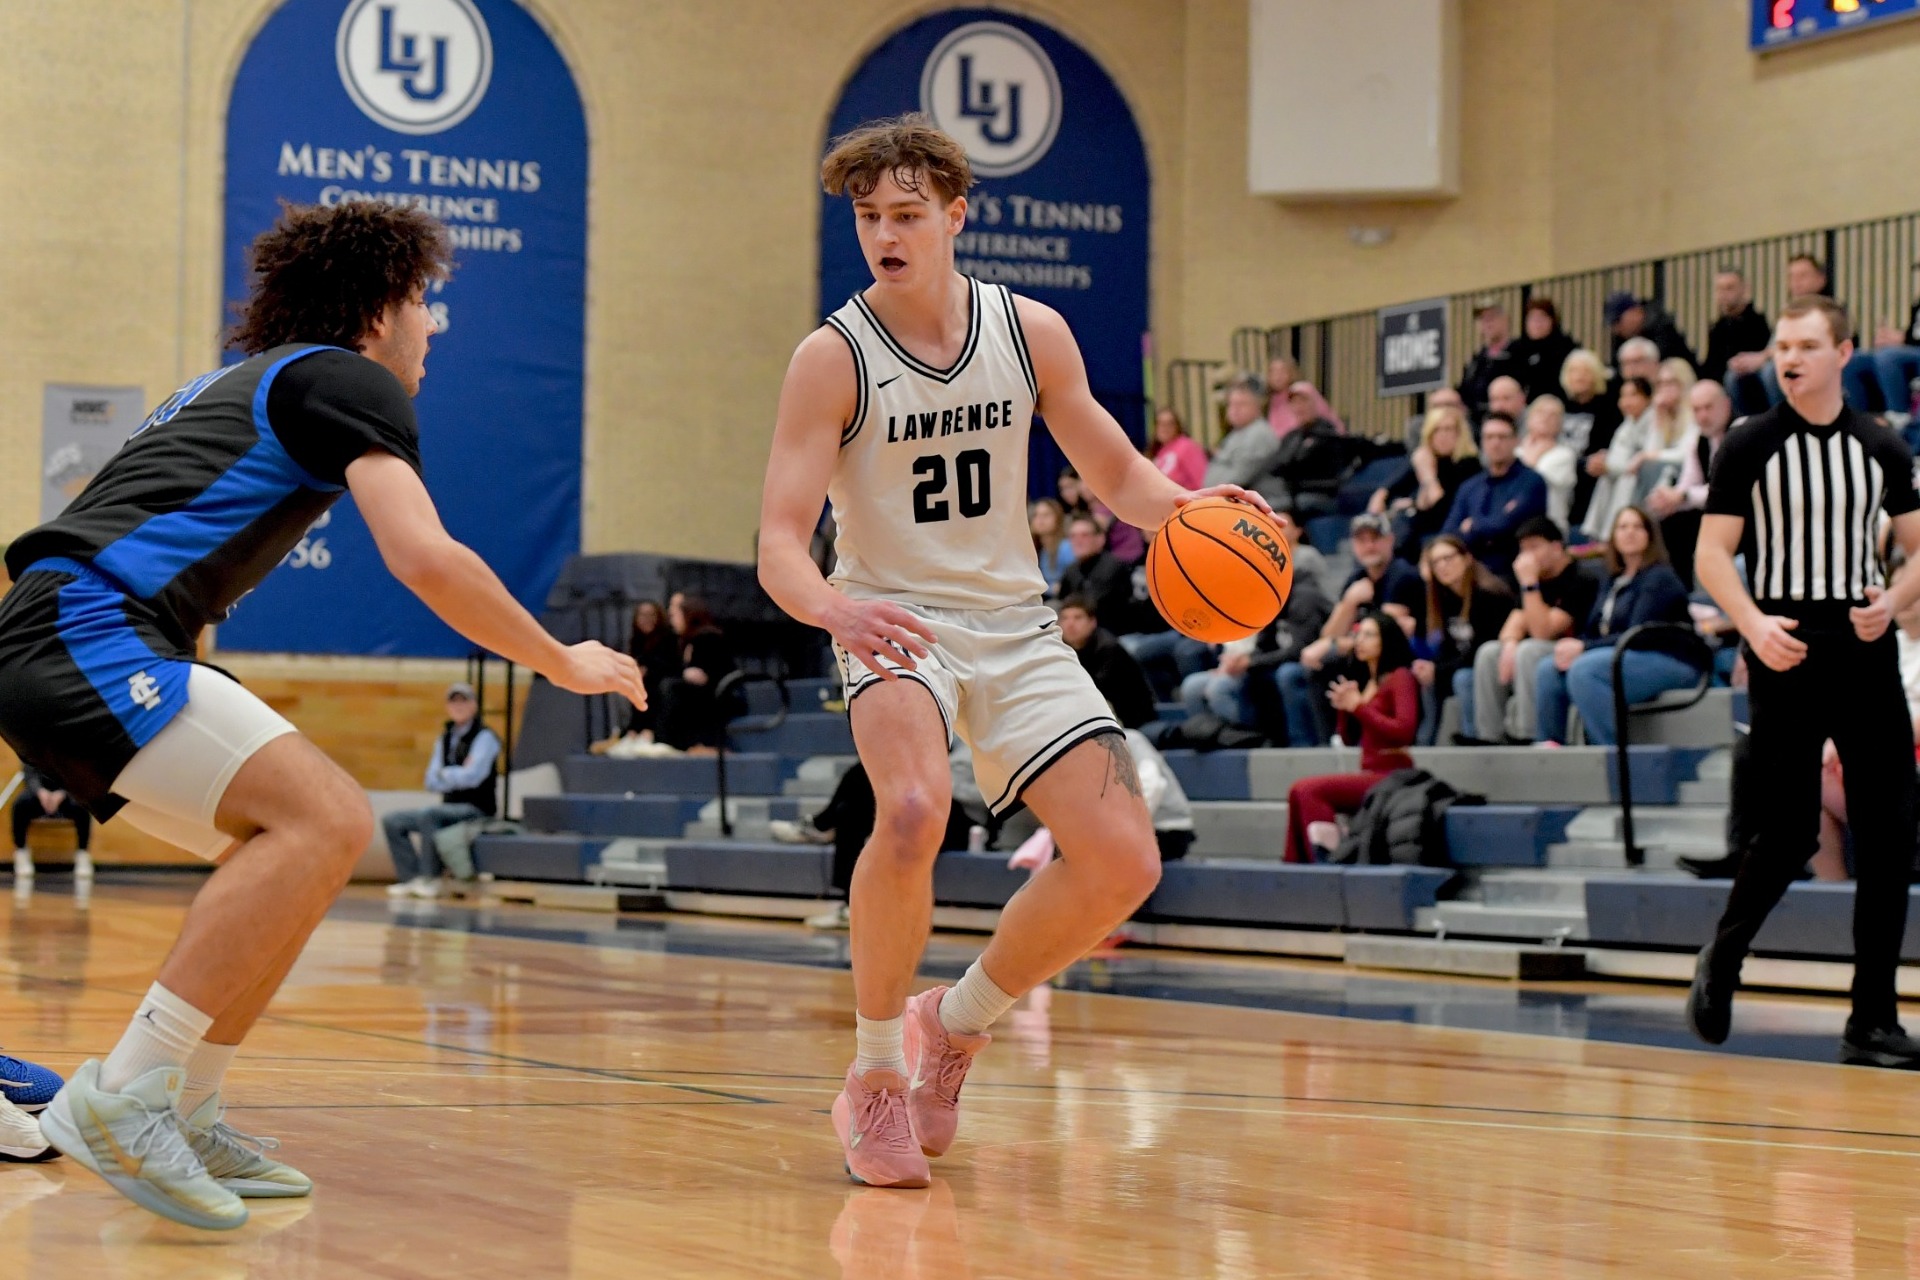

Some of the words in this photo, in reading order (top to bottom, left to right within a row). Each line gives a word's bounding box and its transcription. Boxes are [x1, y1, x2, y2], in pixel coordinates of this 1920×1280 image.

[278, 142, 393, 183] MEN'S
[401, 149, 542, 192] TENNIS
[966, 192, 1002, 226] N'S
[1006, 194, 1123, 234] TENNIS
[955, 231, 1071, 261] NFERENCE
[887, 399, 1013, 444] LAWRENCE
[912, 448, 991, 524] 20
[1232, 518, 1287, 574] NCAA
